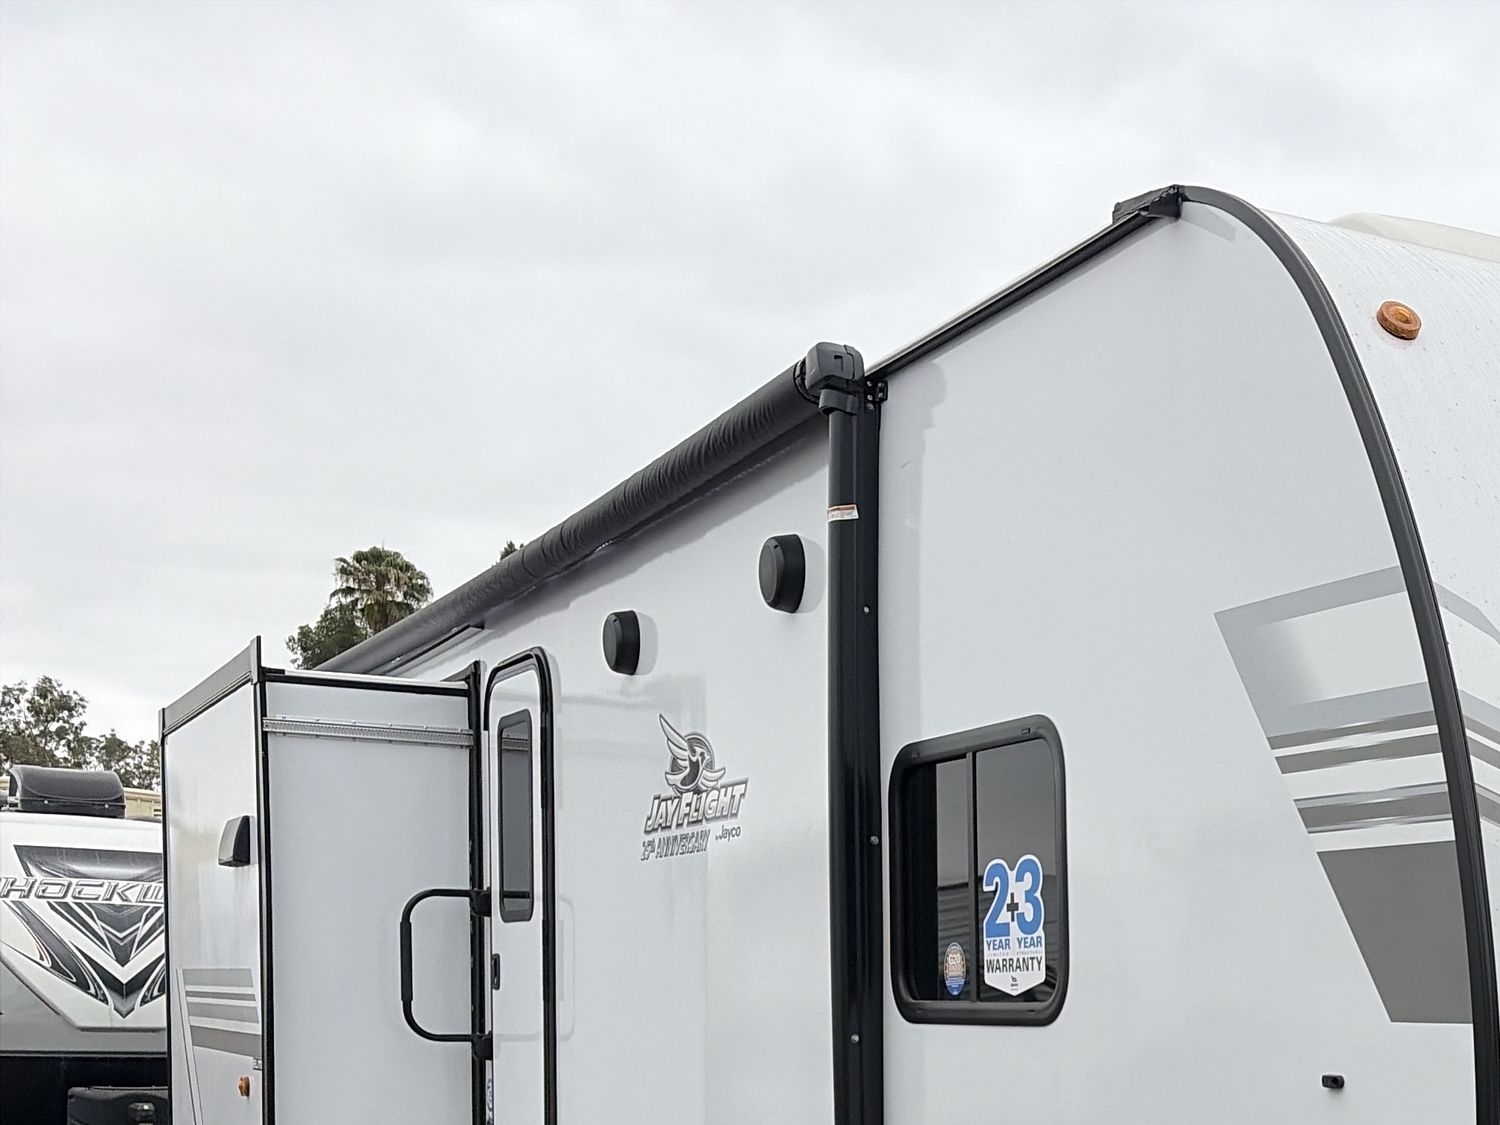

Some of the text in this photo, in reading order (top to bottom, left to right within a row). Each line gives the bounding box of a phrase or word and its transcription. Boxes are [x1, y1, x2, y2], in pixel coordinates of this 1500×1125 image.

[721, 825, 741, 842] Jayco
[655, 829, 711, 859] ANNIVERSARY
[986, 936, 1043, 951] YEAR YEAR
[985, 956, 1043, 974] WARRANTY
